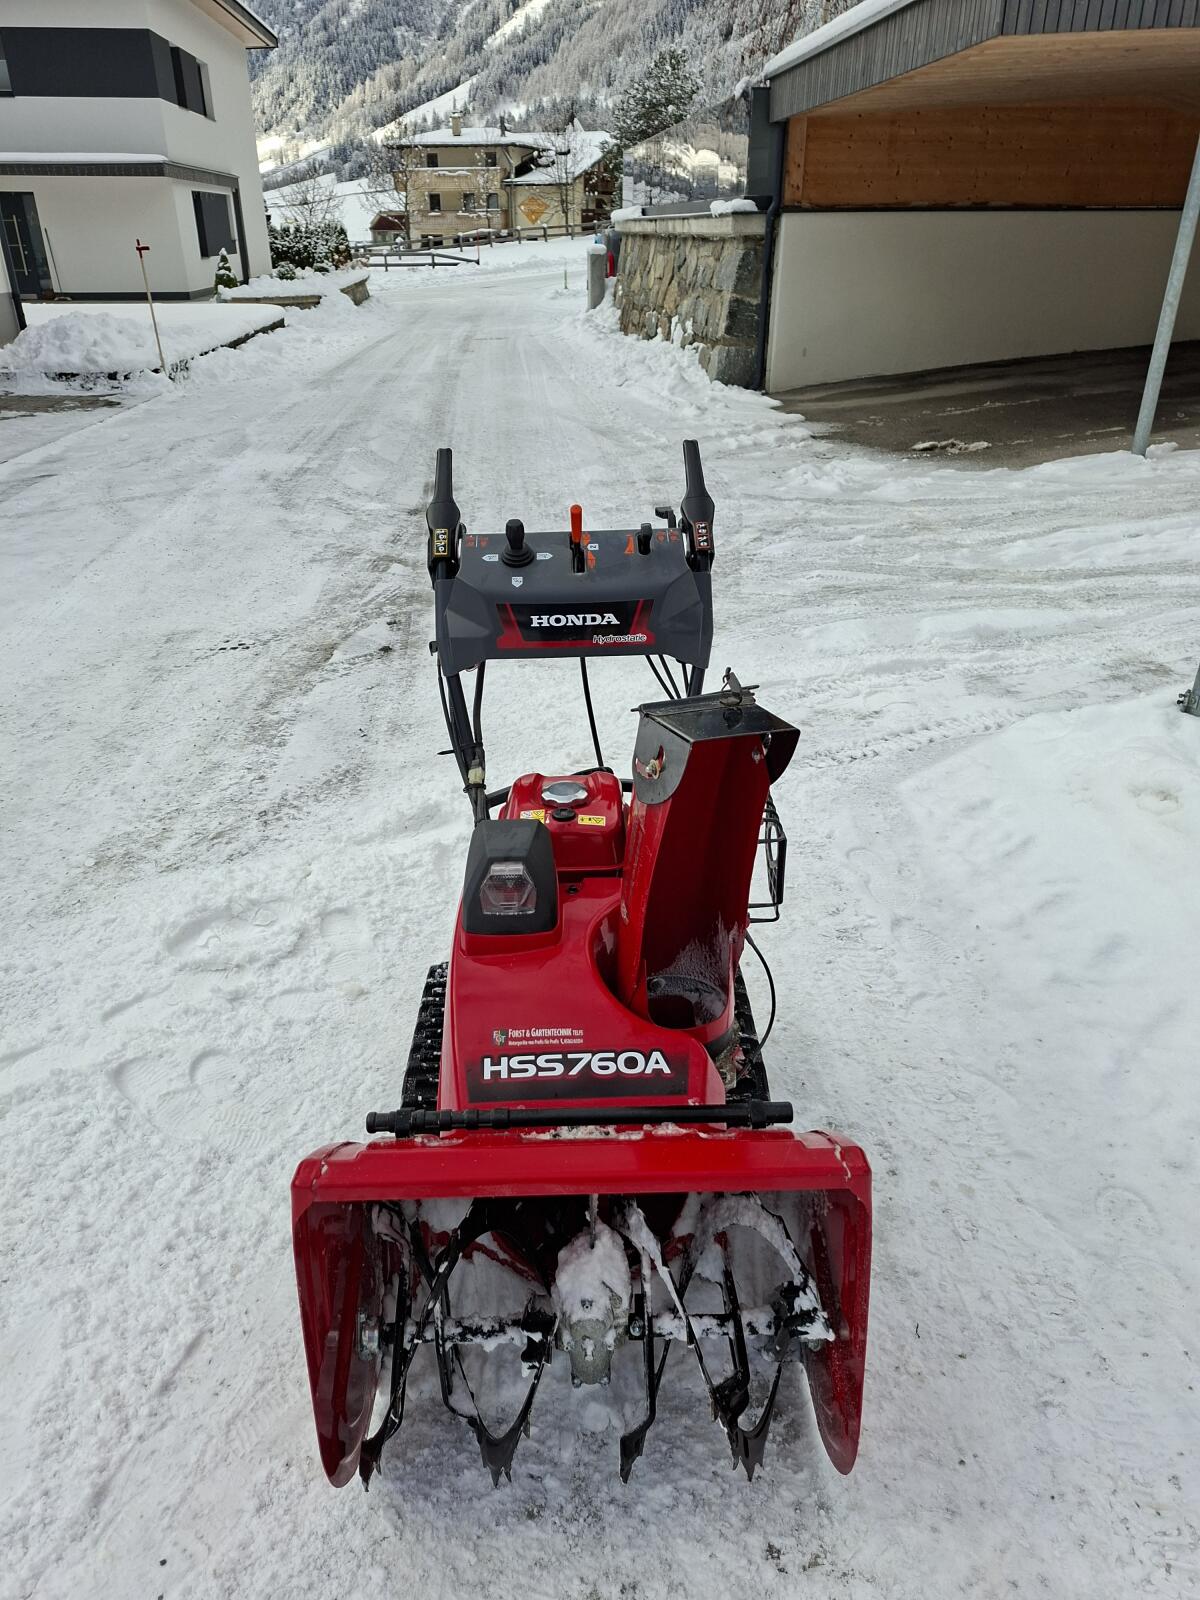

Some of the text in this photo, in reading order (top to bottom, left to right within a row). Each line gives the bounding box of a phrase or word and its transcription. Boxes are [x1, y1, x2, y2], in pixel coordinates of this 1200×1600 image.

[529, 612, 620, 627] HONDA
[592, 632, 648, 645] Hydrostatic
[508, 1029, 525, 1038] FORST
[526, 1029, 530, 1038] &
[531, 1027, 572, 1037] GARTENTECHNIK
[483, 1051, 671, 1080] HSS760A
